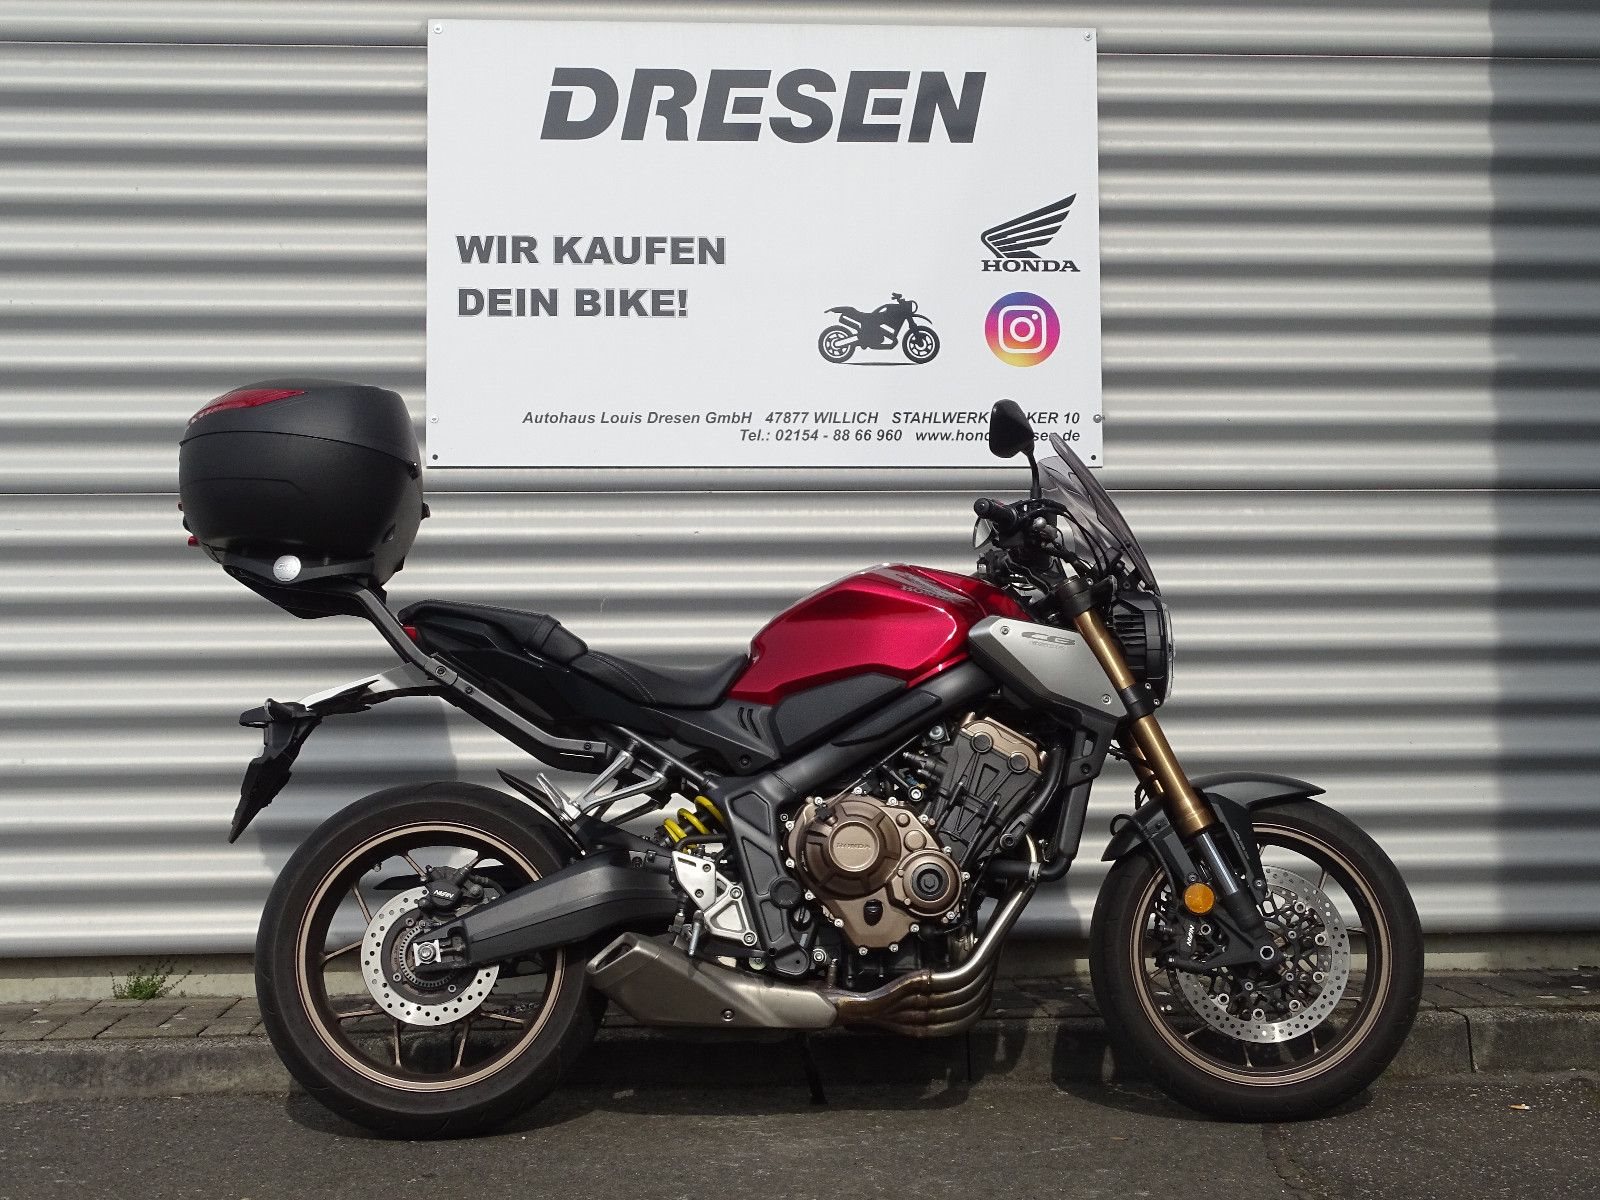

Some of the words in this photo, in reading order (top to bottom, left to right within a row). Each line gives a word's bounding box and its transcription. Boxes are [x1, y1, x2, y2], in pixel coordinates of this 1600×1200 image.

[540, 67, 987, 144] DRESEN
[456, 235, 539, 264] WIR
[553, 235, 726, 265] KAUFEN
[981, 259, 1081, 273] HONDA
[457, 287, 558, 317] DEIN
[575, 287, 688, 318] BIKE!
[522, 411, 596, 424] Autohaus
[600, 411, 643, 424] Louis
[647, 411, 701, 424] Dresen
[705, 411, 753, 424] GmbH
[765, 411, 810, 424] 47877
[814, 411, 880, 424] WILLICH
[892, 411, 990, 424] STAHLWERK
[1063, 411, 1081, 424] 10
[740, 429, 771, 442] Tel.:
[775, 429, 819, 442] 02154
[833, 429, 851, 442] 88
[855, 429, 873, 442] 66
[877, 429, 903, 442] 960
